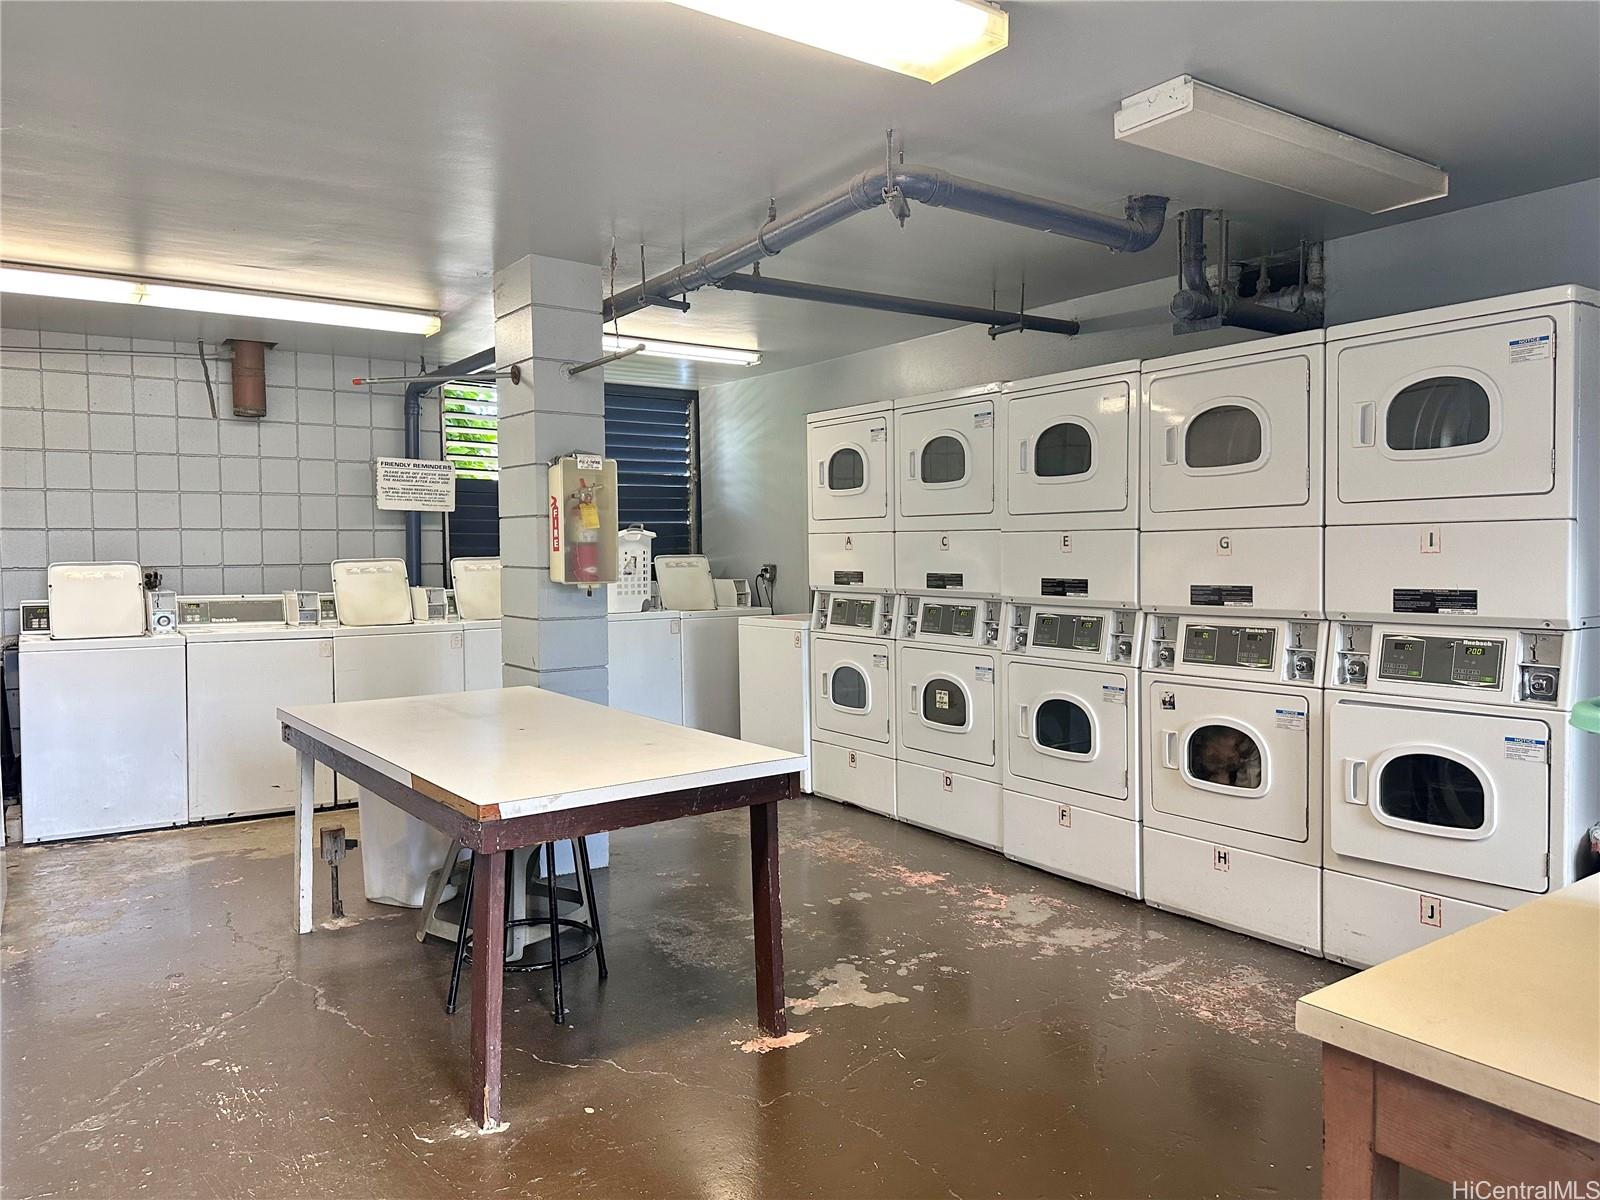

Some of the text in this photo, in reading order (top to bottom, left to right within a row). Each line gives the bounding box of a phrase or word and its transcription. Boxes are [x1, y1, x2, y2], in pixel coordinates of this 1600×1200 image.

[846, 536, 852, 545] A
[942, 536, 948, 546] C
[1063, 536, 1069, 546] E
[1220, 536, 1229, 548] G
[850, 754, 856, 762] B
[946, 776, 952, 786] D
[1061, 810, 1067, 820] F
[1218, 851, 1227, 865] H
[1428, 905, 1435, 919] J
